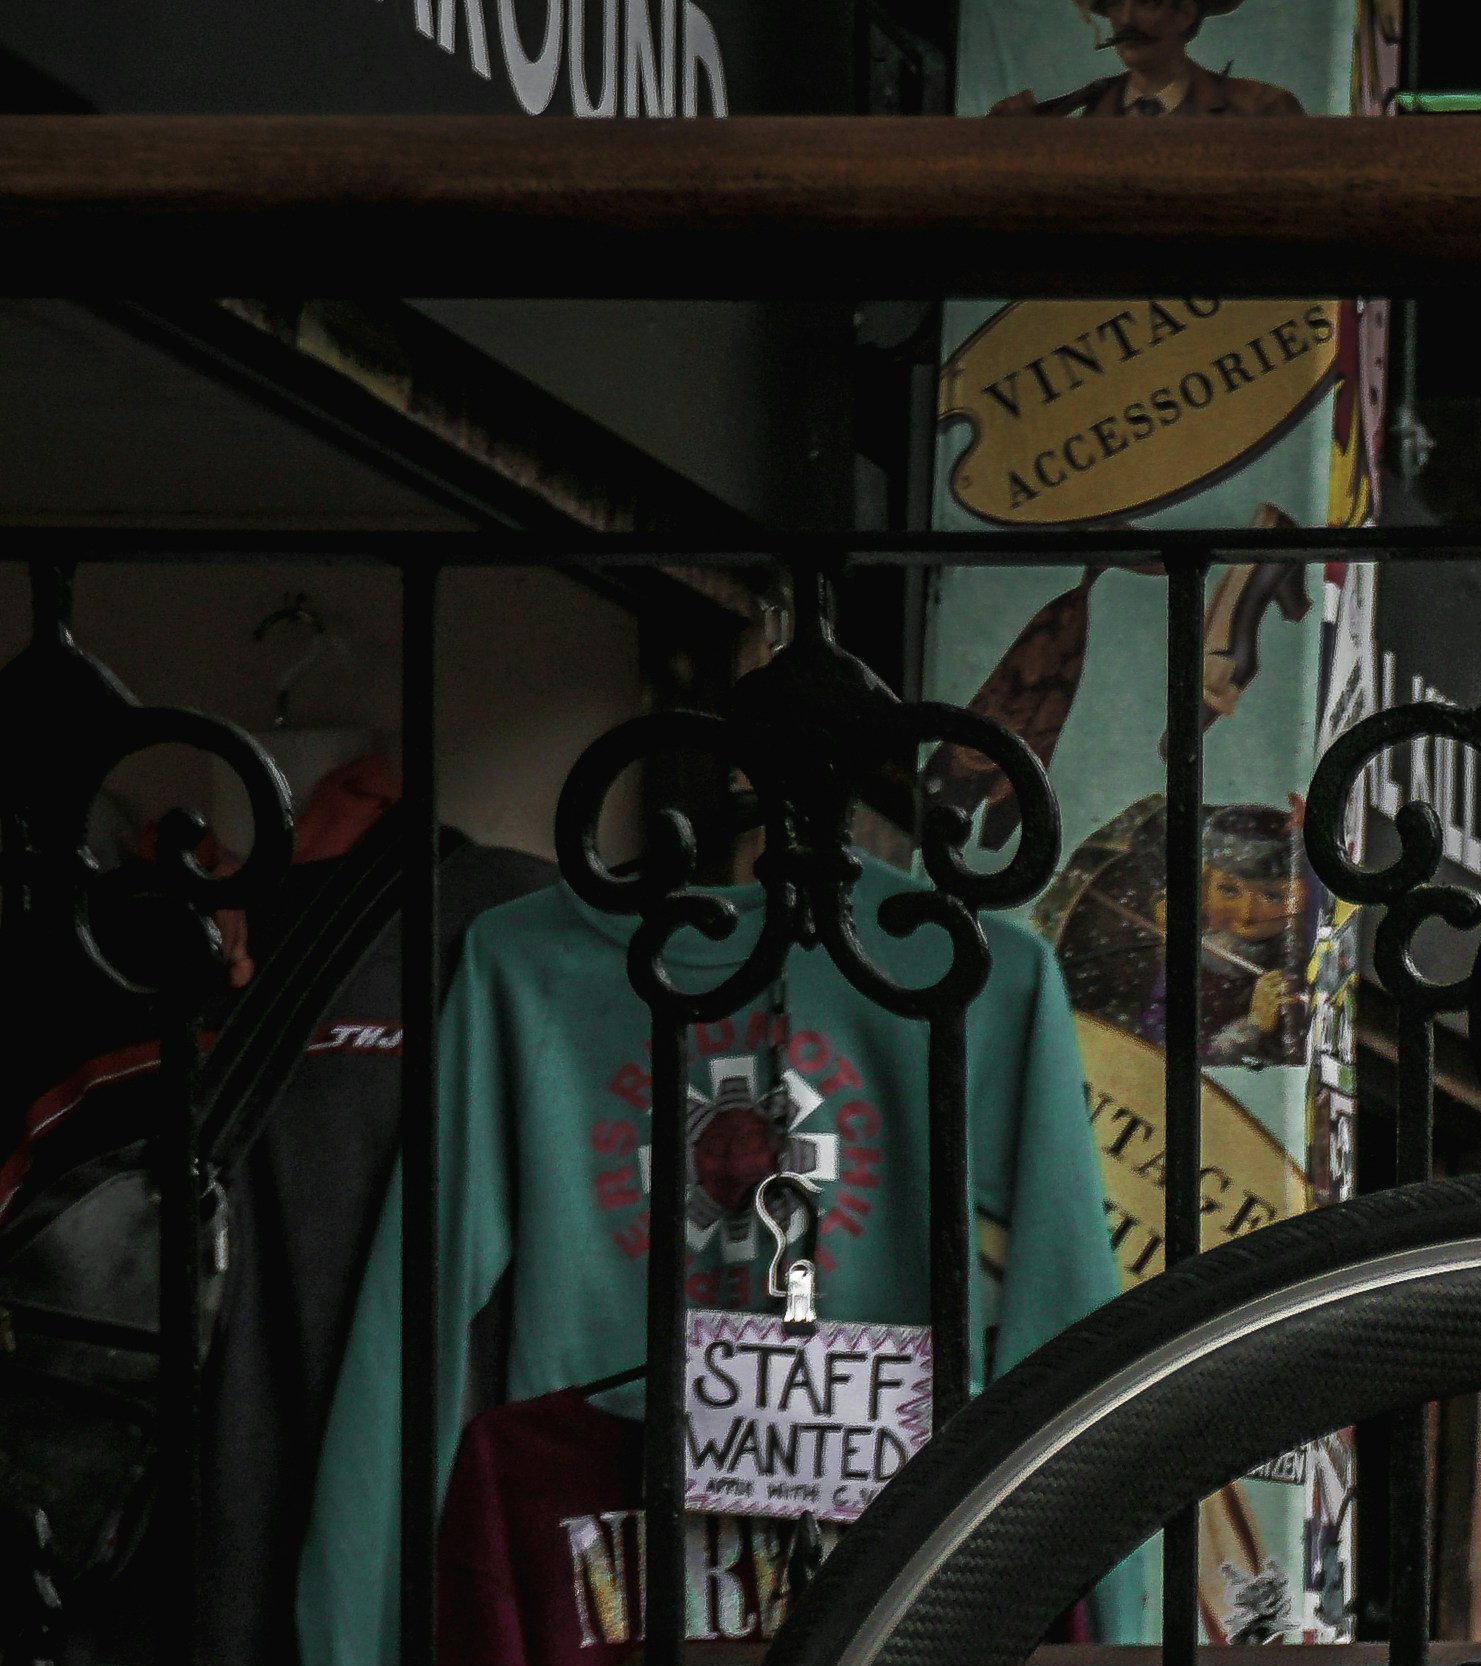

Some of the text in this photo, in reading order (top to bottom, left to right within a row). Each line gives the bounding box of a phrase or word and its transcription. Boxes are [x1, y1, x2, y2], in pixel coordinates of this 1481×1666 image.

[1008, 304, 1335, 510] ACCESSORIES
[692, 1339, 911, 1420] STAFF
[684, 1415, 910, 1483] WANTED
